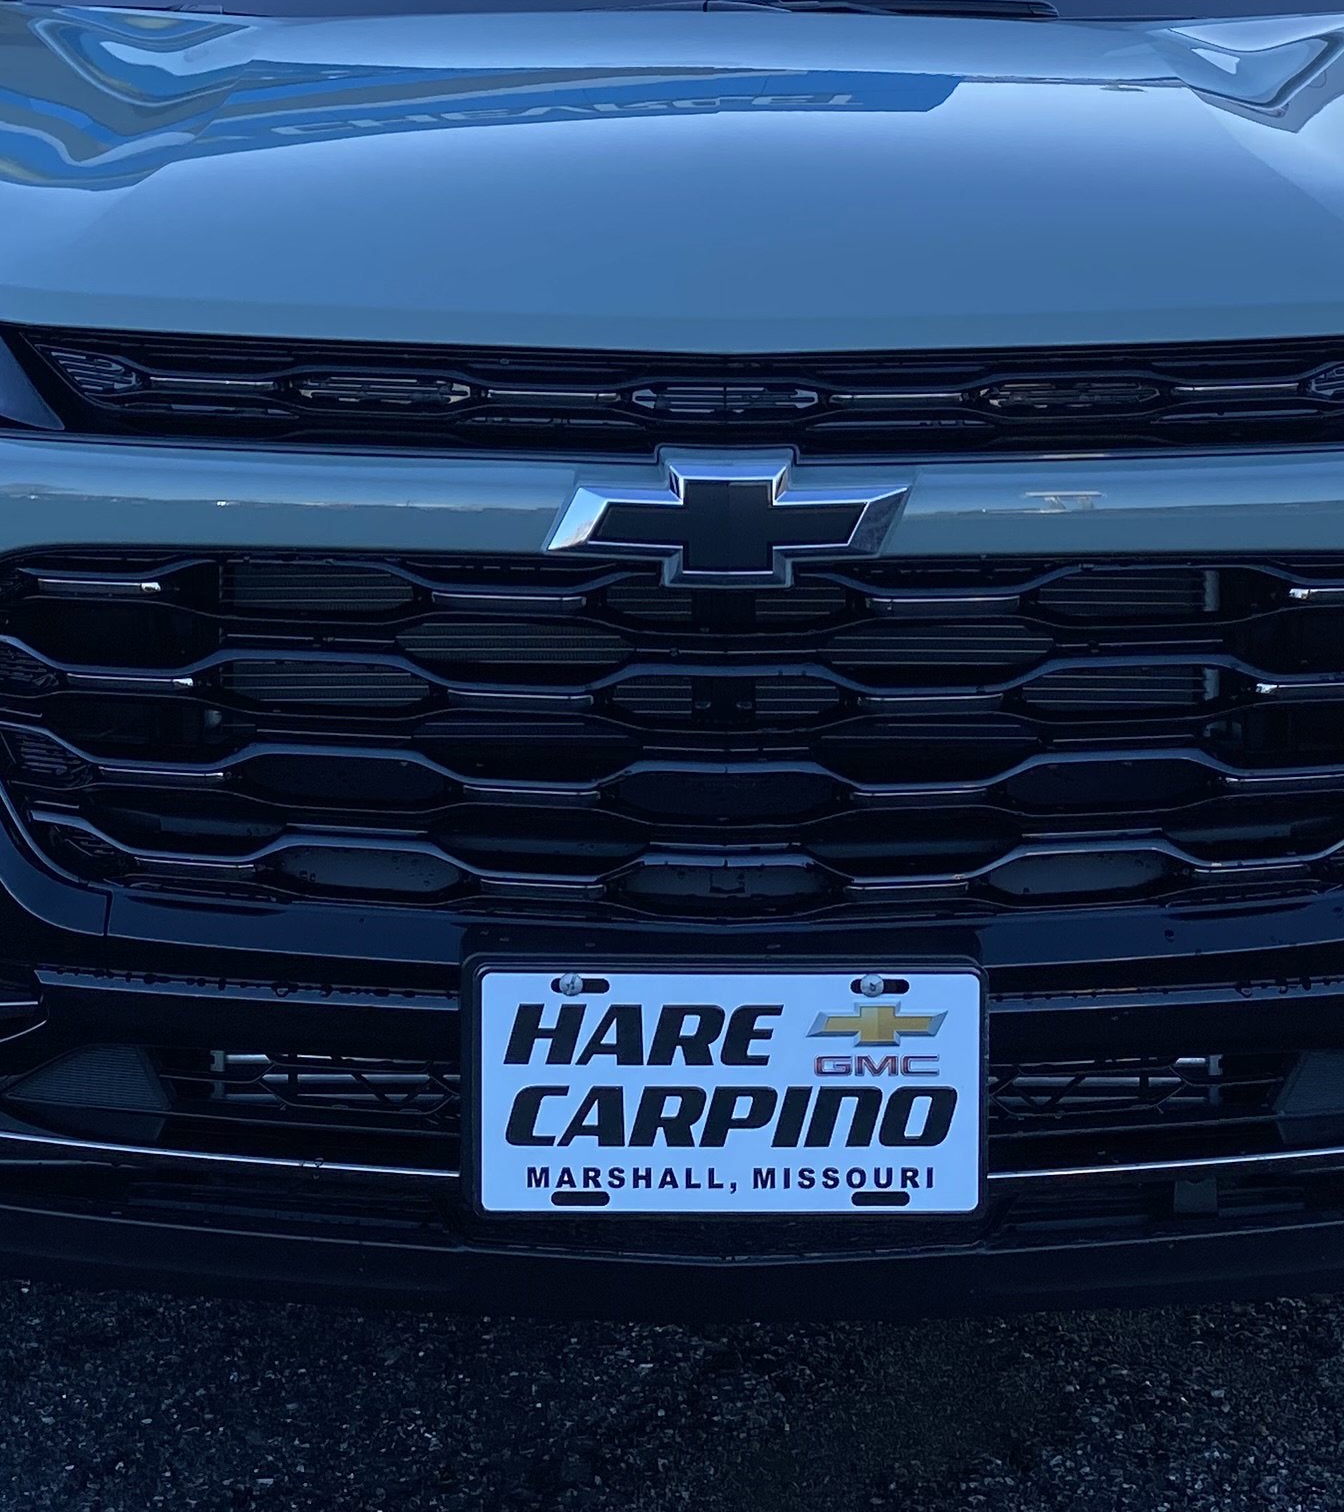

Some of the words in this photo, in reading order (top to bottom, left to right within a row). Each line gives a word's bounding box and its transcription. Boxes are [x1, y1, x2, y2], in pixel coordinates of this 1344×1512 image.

[502, 1003, 784, 1066] HARE
[813, 1054, 940, 1077] GMC
[504, 1085, 958, 1148] CARPINO
[526, 1166, 738, 1194] MARSHALL,
[753, 1167, 935, 1189] MISSOURI
